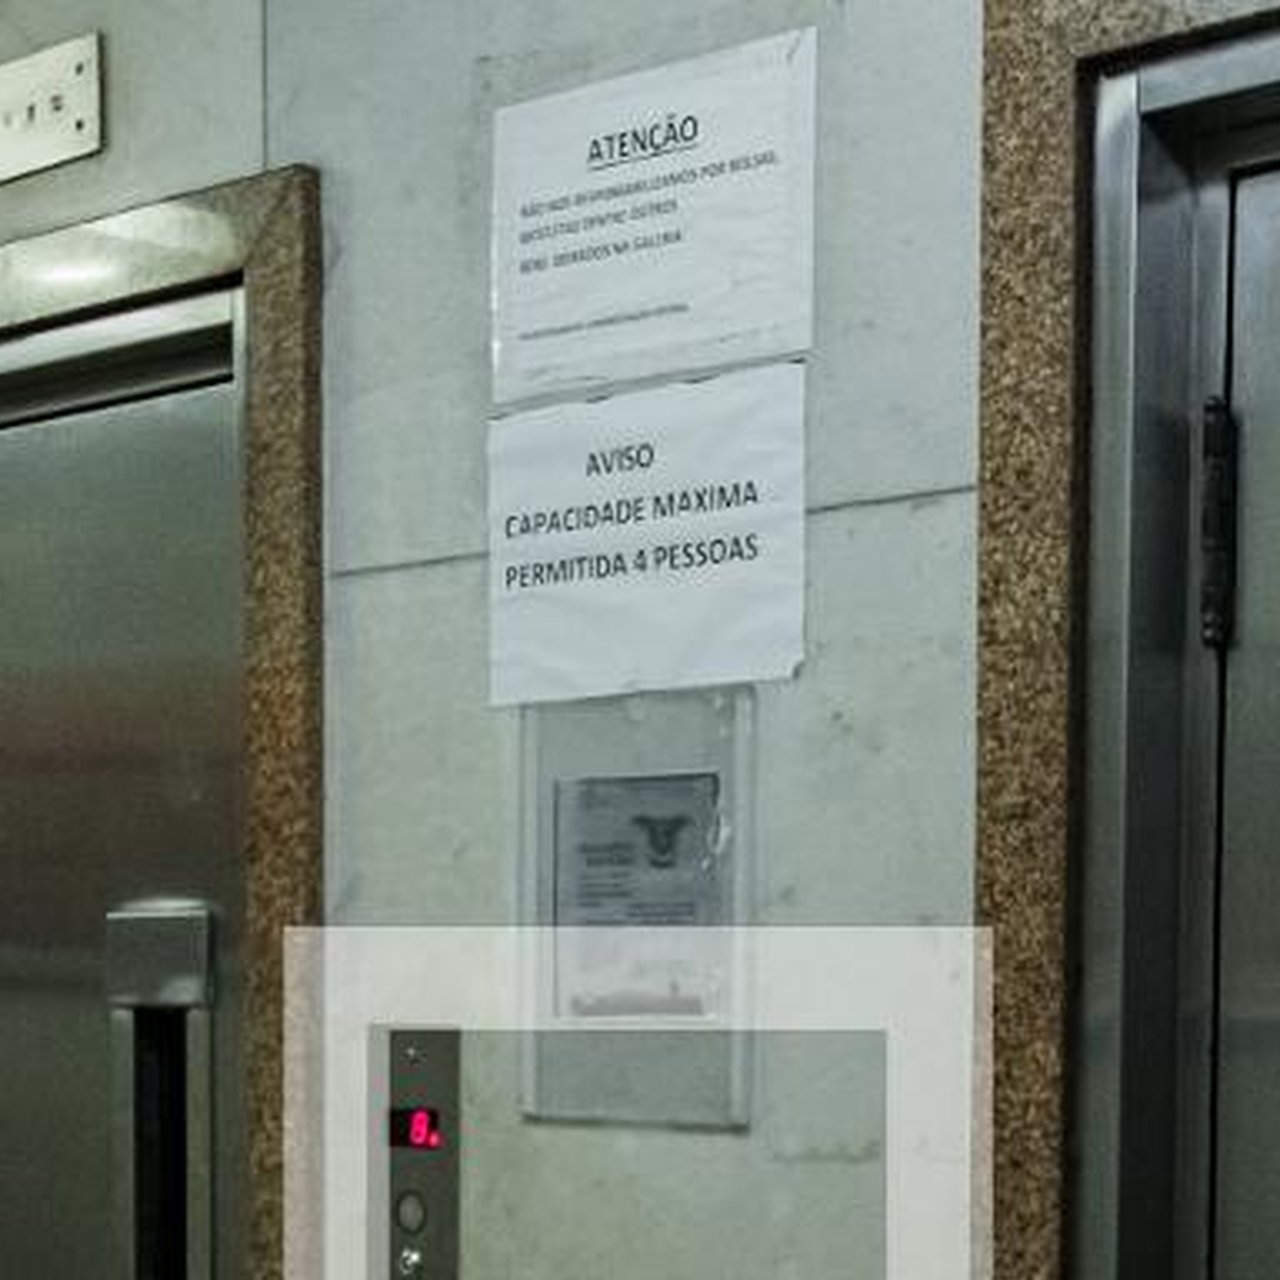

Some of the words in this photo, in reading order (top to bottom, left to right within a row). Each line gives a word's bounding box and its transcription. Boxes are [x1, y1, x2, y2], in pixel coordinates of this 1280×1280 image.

[586, 112, 699, 166] ATENÇÃO
[585, 442, 656, 478] AVISO
[504, 498, 646, 540] CAPACIDADE
[651, 480, 760, 521] MAXIMA
[505, 552, 629, 590] PERMITIDA
[632, 548, 649, 574] 4
[653, 532, 759, 573] PESSOAS
